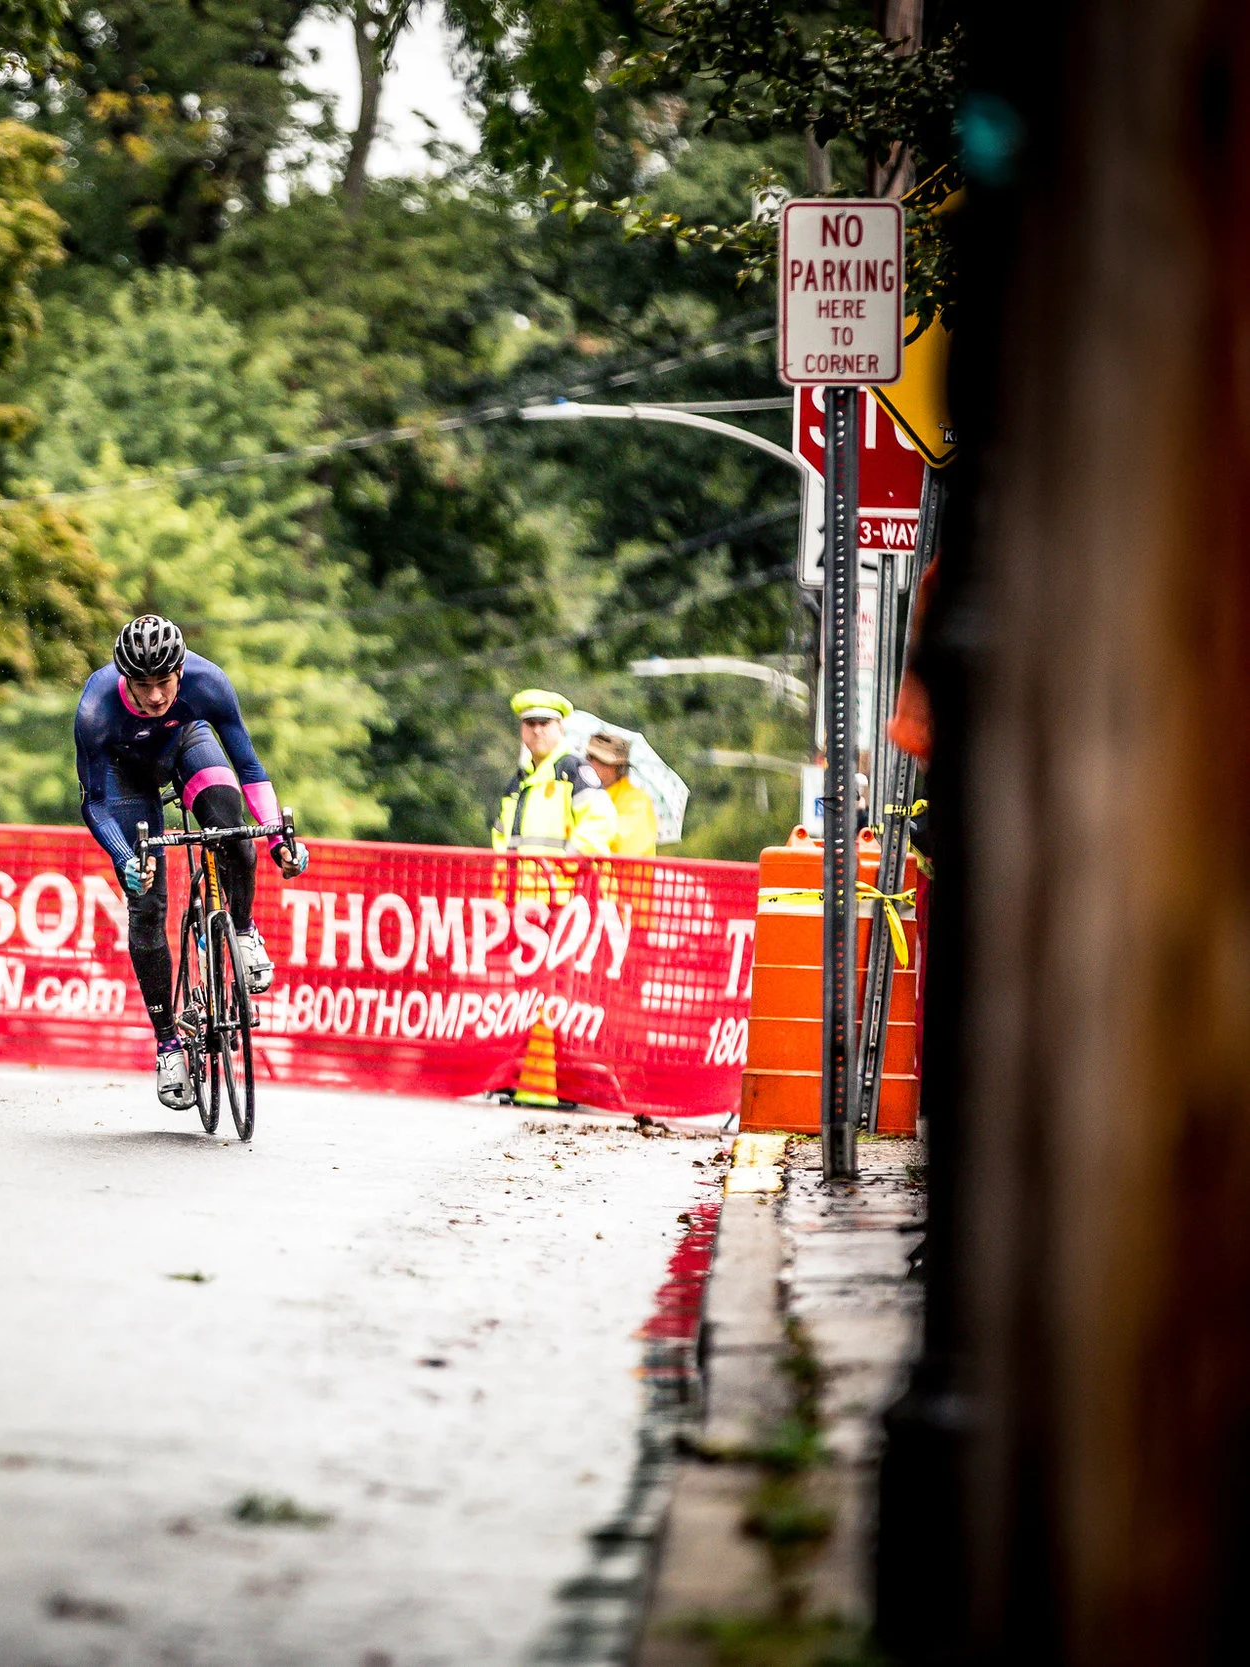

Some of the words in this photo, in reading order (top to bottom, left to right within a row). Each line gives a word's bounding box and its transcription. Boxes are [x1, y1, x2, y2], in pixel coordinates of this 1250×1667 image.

[821, 214, 863, 248] NO
[790, 260, 895, 292] PARKING
[818, 300, 867, 319] HERE
[831, 327, 854, 346] TO
[805, 355, 879, 374] CORNER
[859, 521, 918, 546] 3-WAY
[282, 888, 632, 980] THOMPSON
